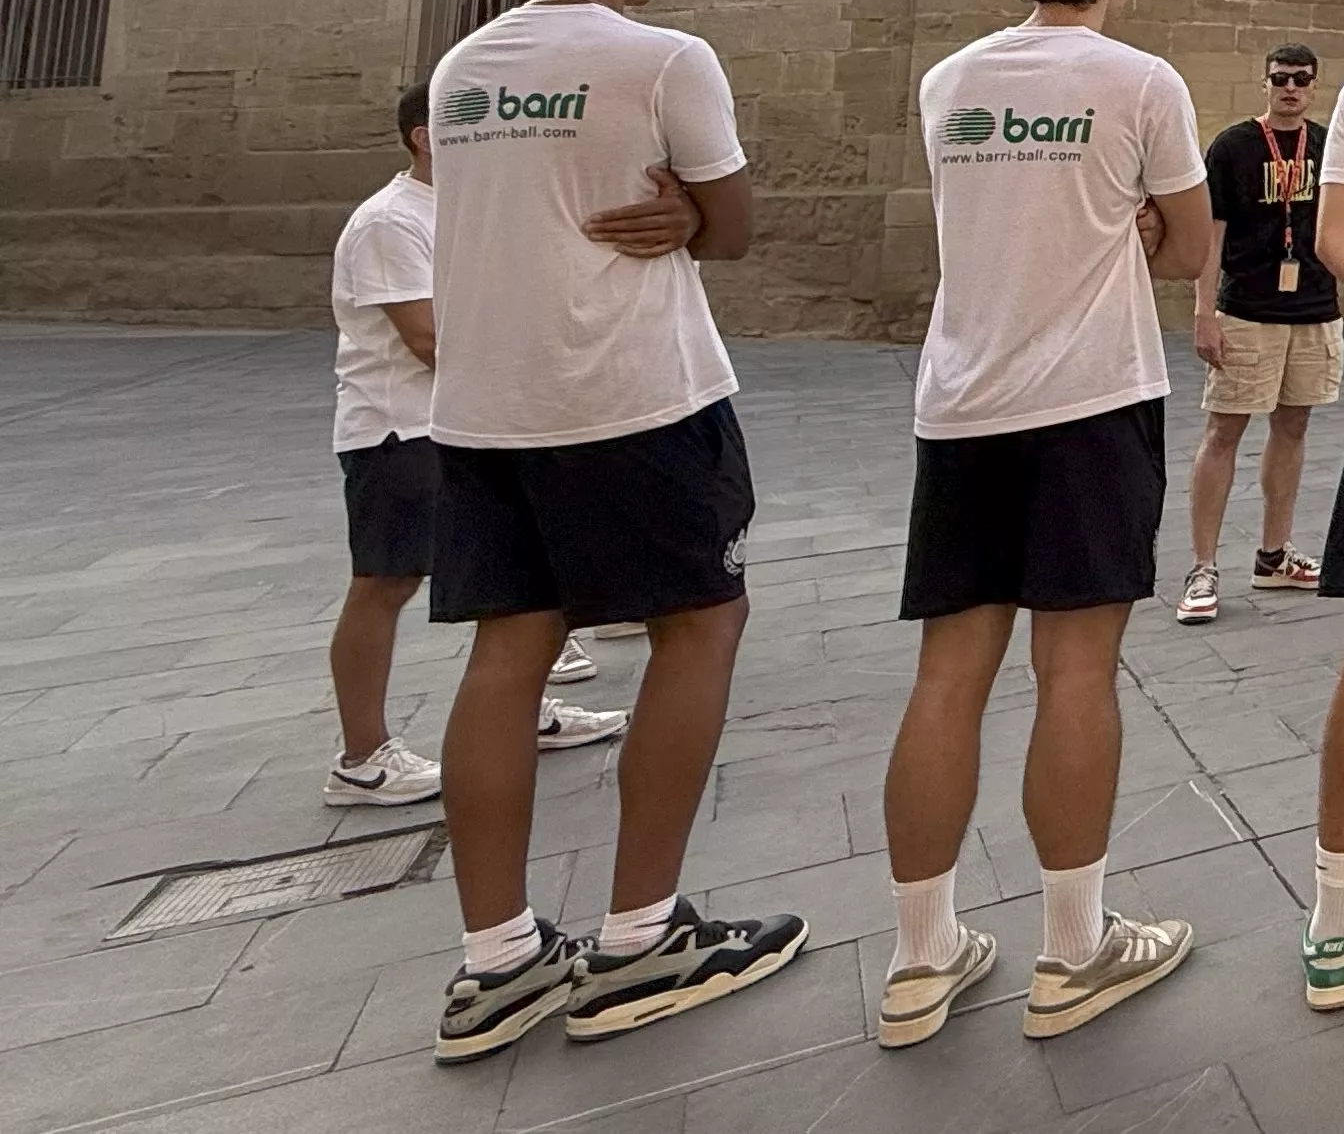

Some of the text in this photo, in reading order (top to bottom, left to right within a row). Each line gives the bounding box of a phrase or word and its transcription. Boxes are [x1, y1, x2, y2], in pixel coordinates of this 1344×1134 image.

[497, 83, 590, 121] barri
[438, 126, 577, 146] www.barri-ball.com
[1002, 108, 1096, 144] barri
[941, 149, 1082, 164] www.barri-ball.com
